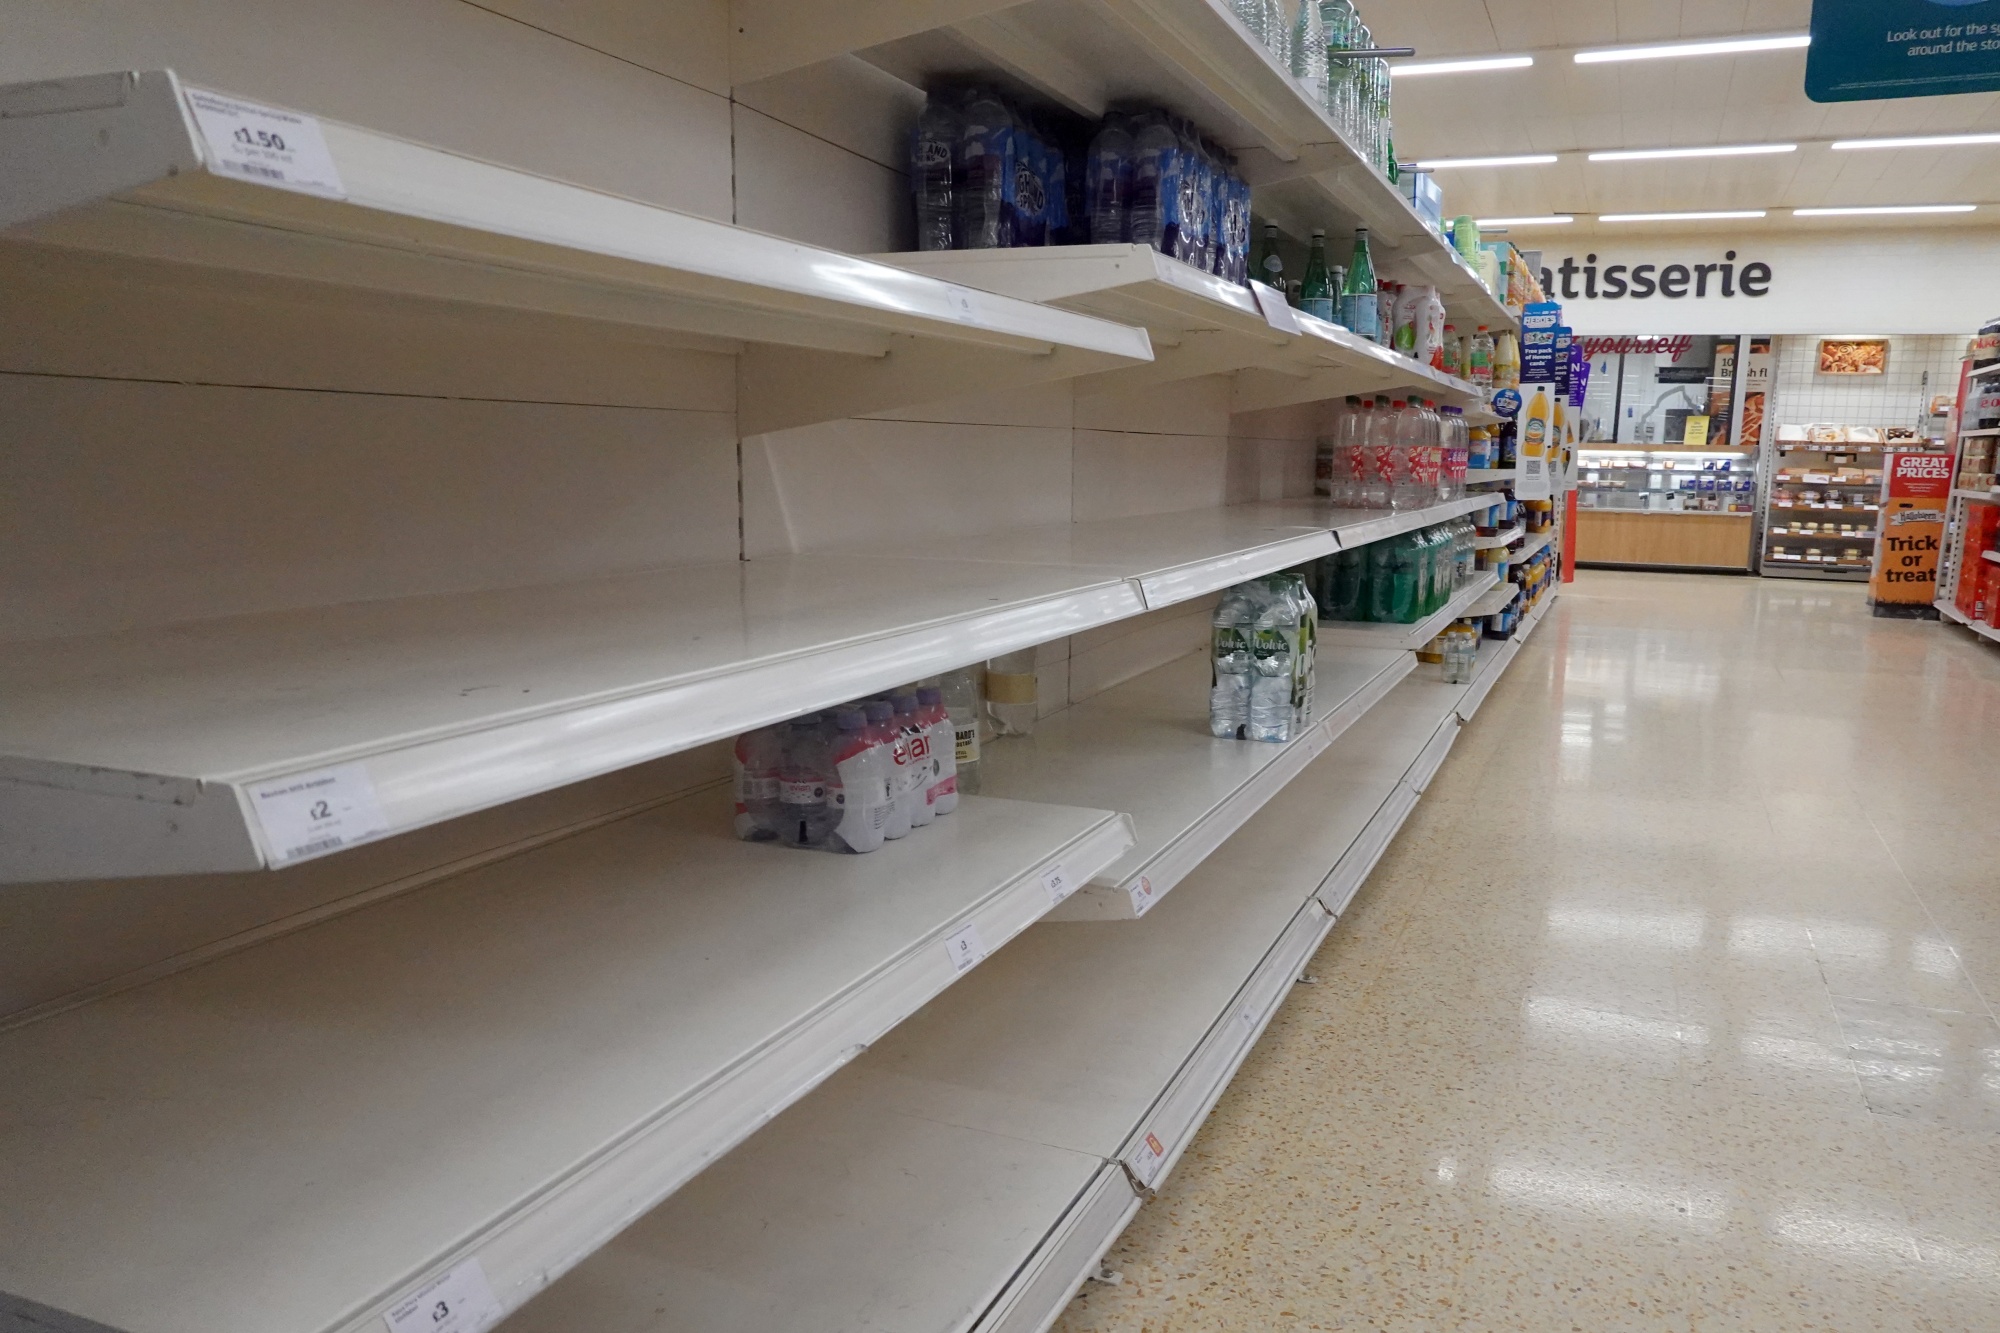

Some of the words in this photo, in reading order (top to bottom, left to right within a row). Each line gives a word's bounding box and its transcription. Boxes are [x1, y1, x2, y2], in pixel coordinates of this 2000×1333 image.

[1887, 28, 1917, 42] Look
[1920, 27, 1942, 39] out
[1944, 24, 1962, 37] for
[1966, 23, 1988, 36] the
[1907, 41, 1953, 56] around
[1956, 40, 1977, 53] the
[234, 127, 286, 151] £1.50
[1900, 456, 1949, 468] GREAT
[1896, 467, 1950, 479] PRICES
[1887, 535, 1939, 551] Trick
[1901, 556, 1923, 567] or
[1885, 568, 1937, 583] treat
[310, 800, 333, 821] £2
[432, 1301, 450, 1323] £3
